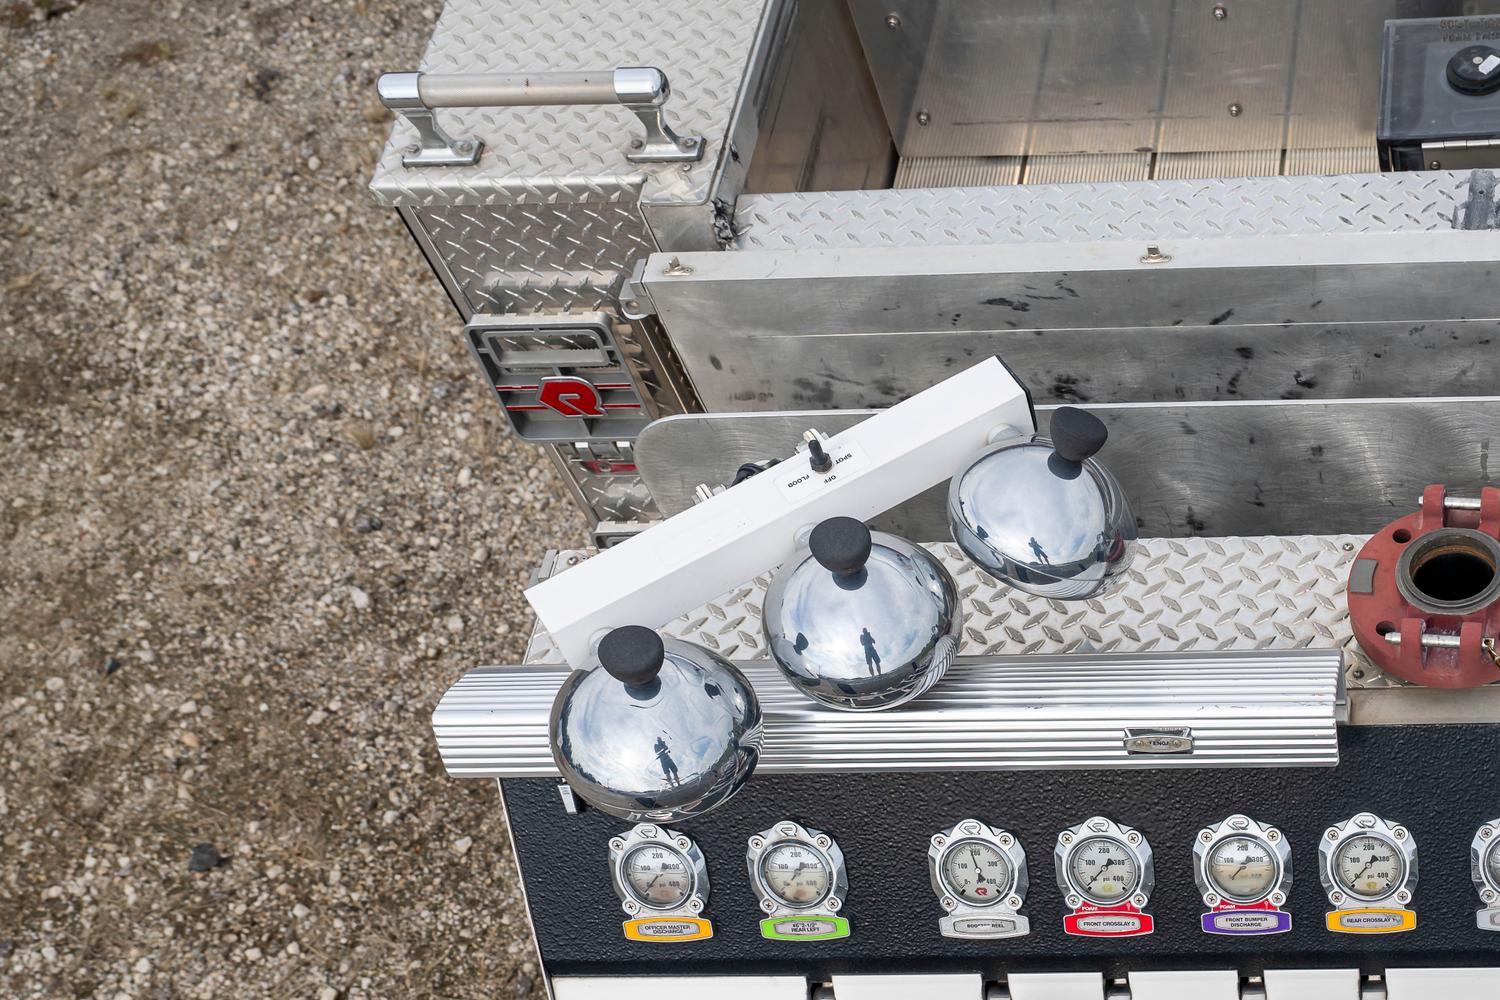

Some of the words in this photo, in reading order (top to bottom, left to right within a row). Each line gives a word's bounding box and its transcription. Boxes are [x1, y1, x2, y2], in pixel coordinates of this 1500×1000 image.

[835, 453, 852, 464] SPOT
[788, 474, 810, 487] FLOOD
[824, 475, 836, 484] OFF
